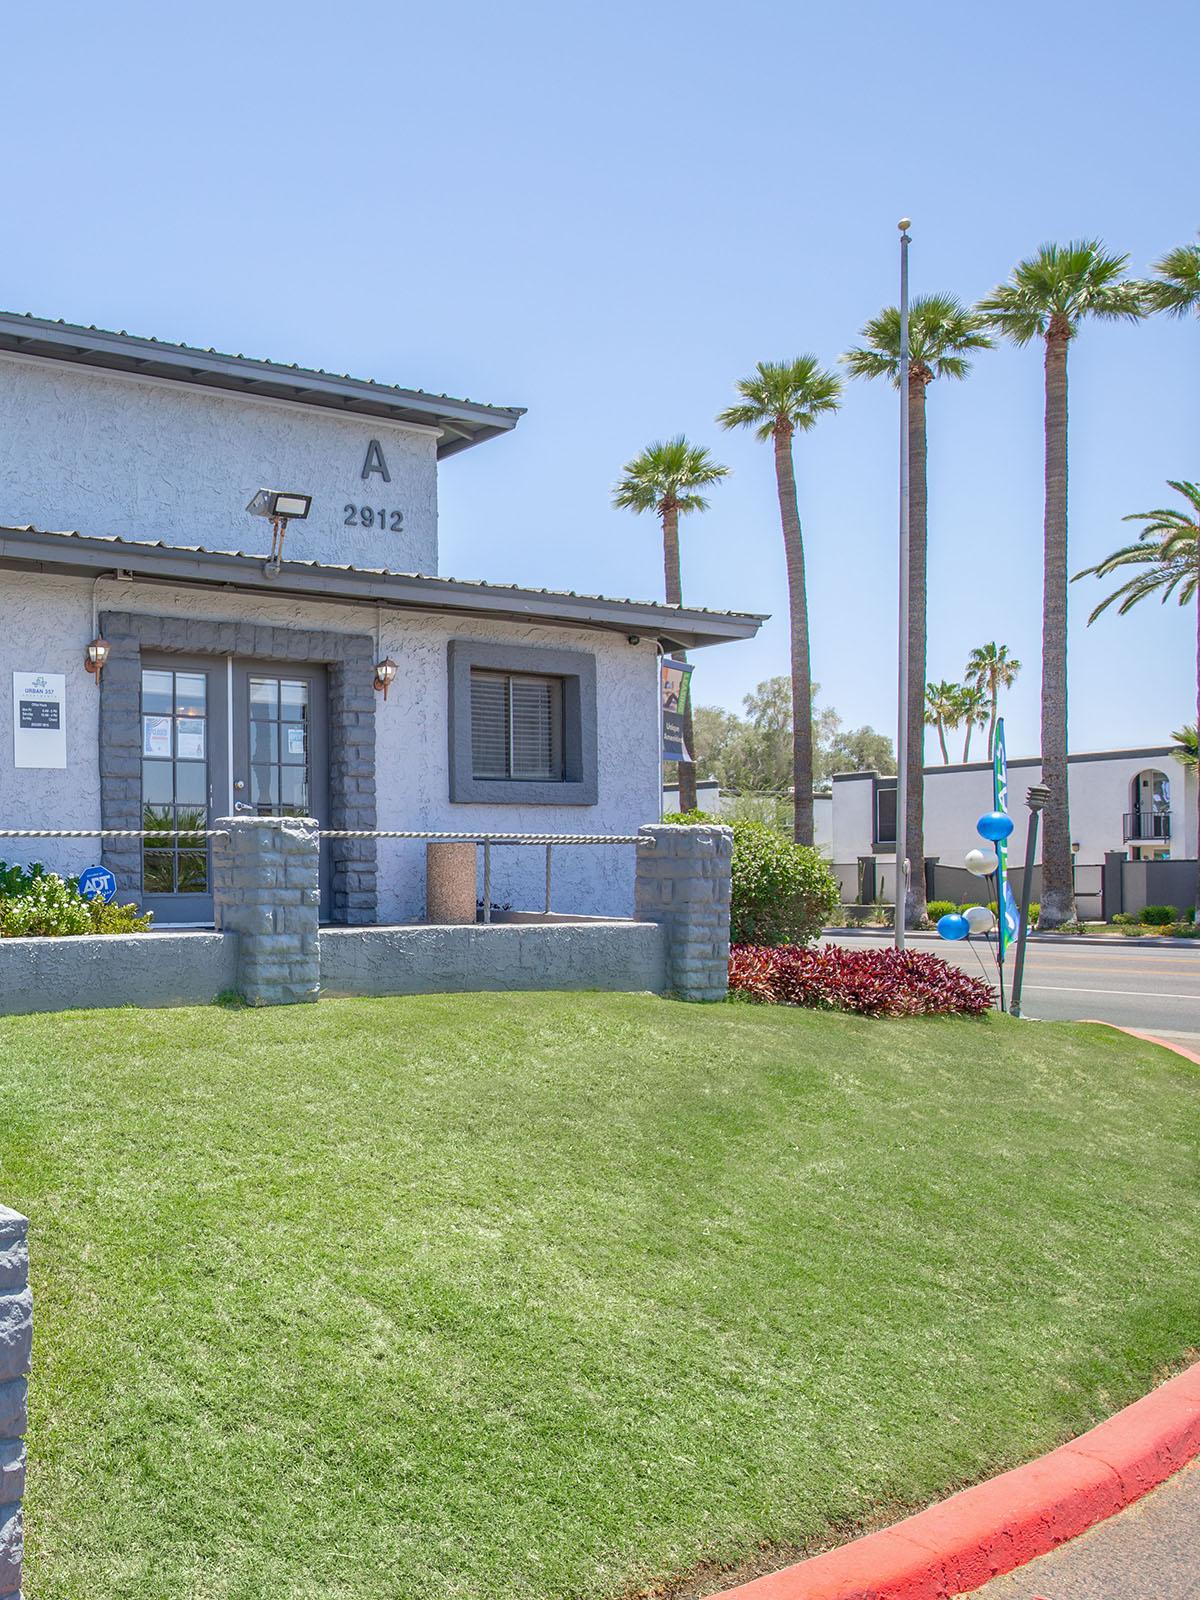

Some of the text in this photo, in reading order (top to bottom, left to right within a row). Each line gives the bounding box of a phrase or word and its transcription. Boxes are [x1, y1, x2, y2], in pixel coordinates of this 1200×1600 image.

[361, 439, 392, 483] A
[343, 503, 404, 532] 2912
[83, 874, 111, 894] ADT
